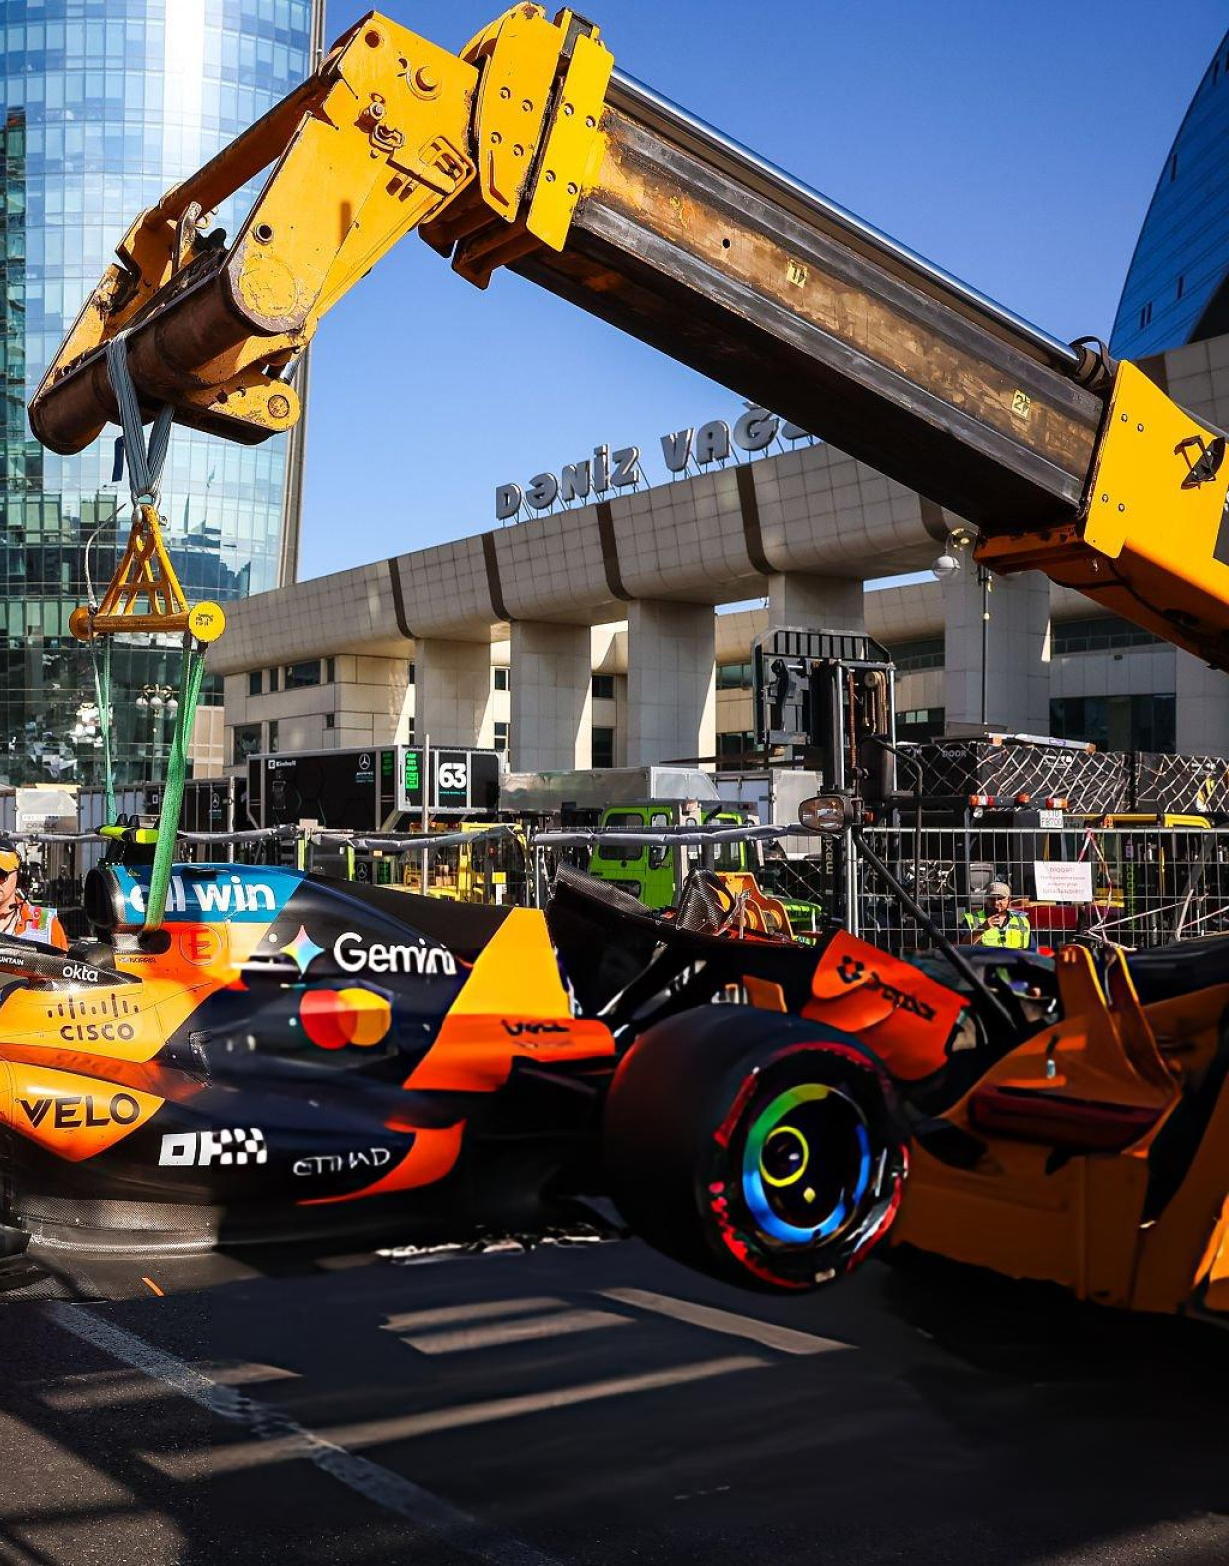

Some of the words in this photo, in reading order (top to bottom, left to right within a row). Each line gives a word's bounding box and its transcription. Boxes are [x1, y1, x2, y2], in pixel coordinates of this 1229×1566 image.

[660, 401, 810, 473] VAĞ
[439, 763, 467, 789] 63
[192, 875, 276, 912] win
[333, 931, 457, 976] Gemini
[62, 963, 99, 983] okta
[60, 1023, 134, 1041] CISCO
[20, 1092, 141, 1130] VELO
